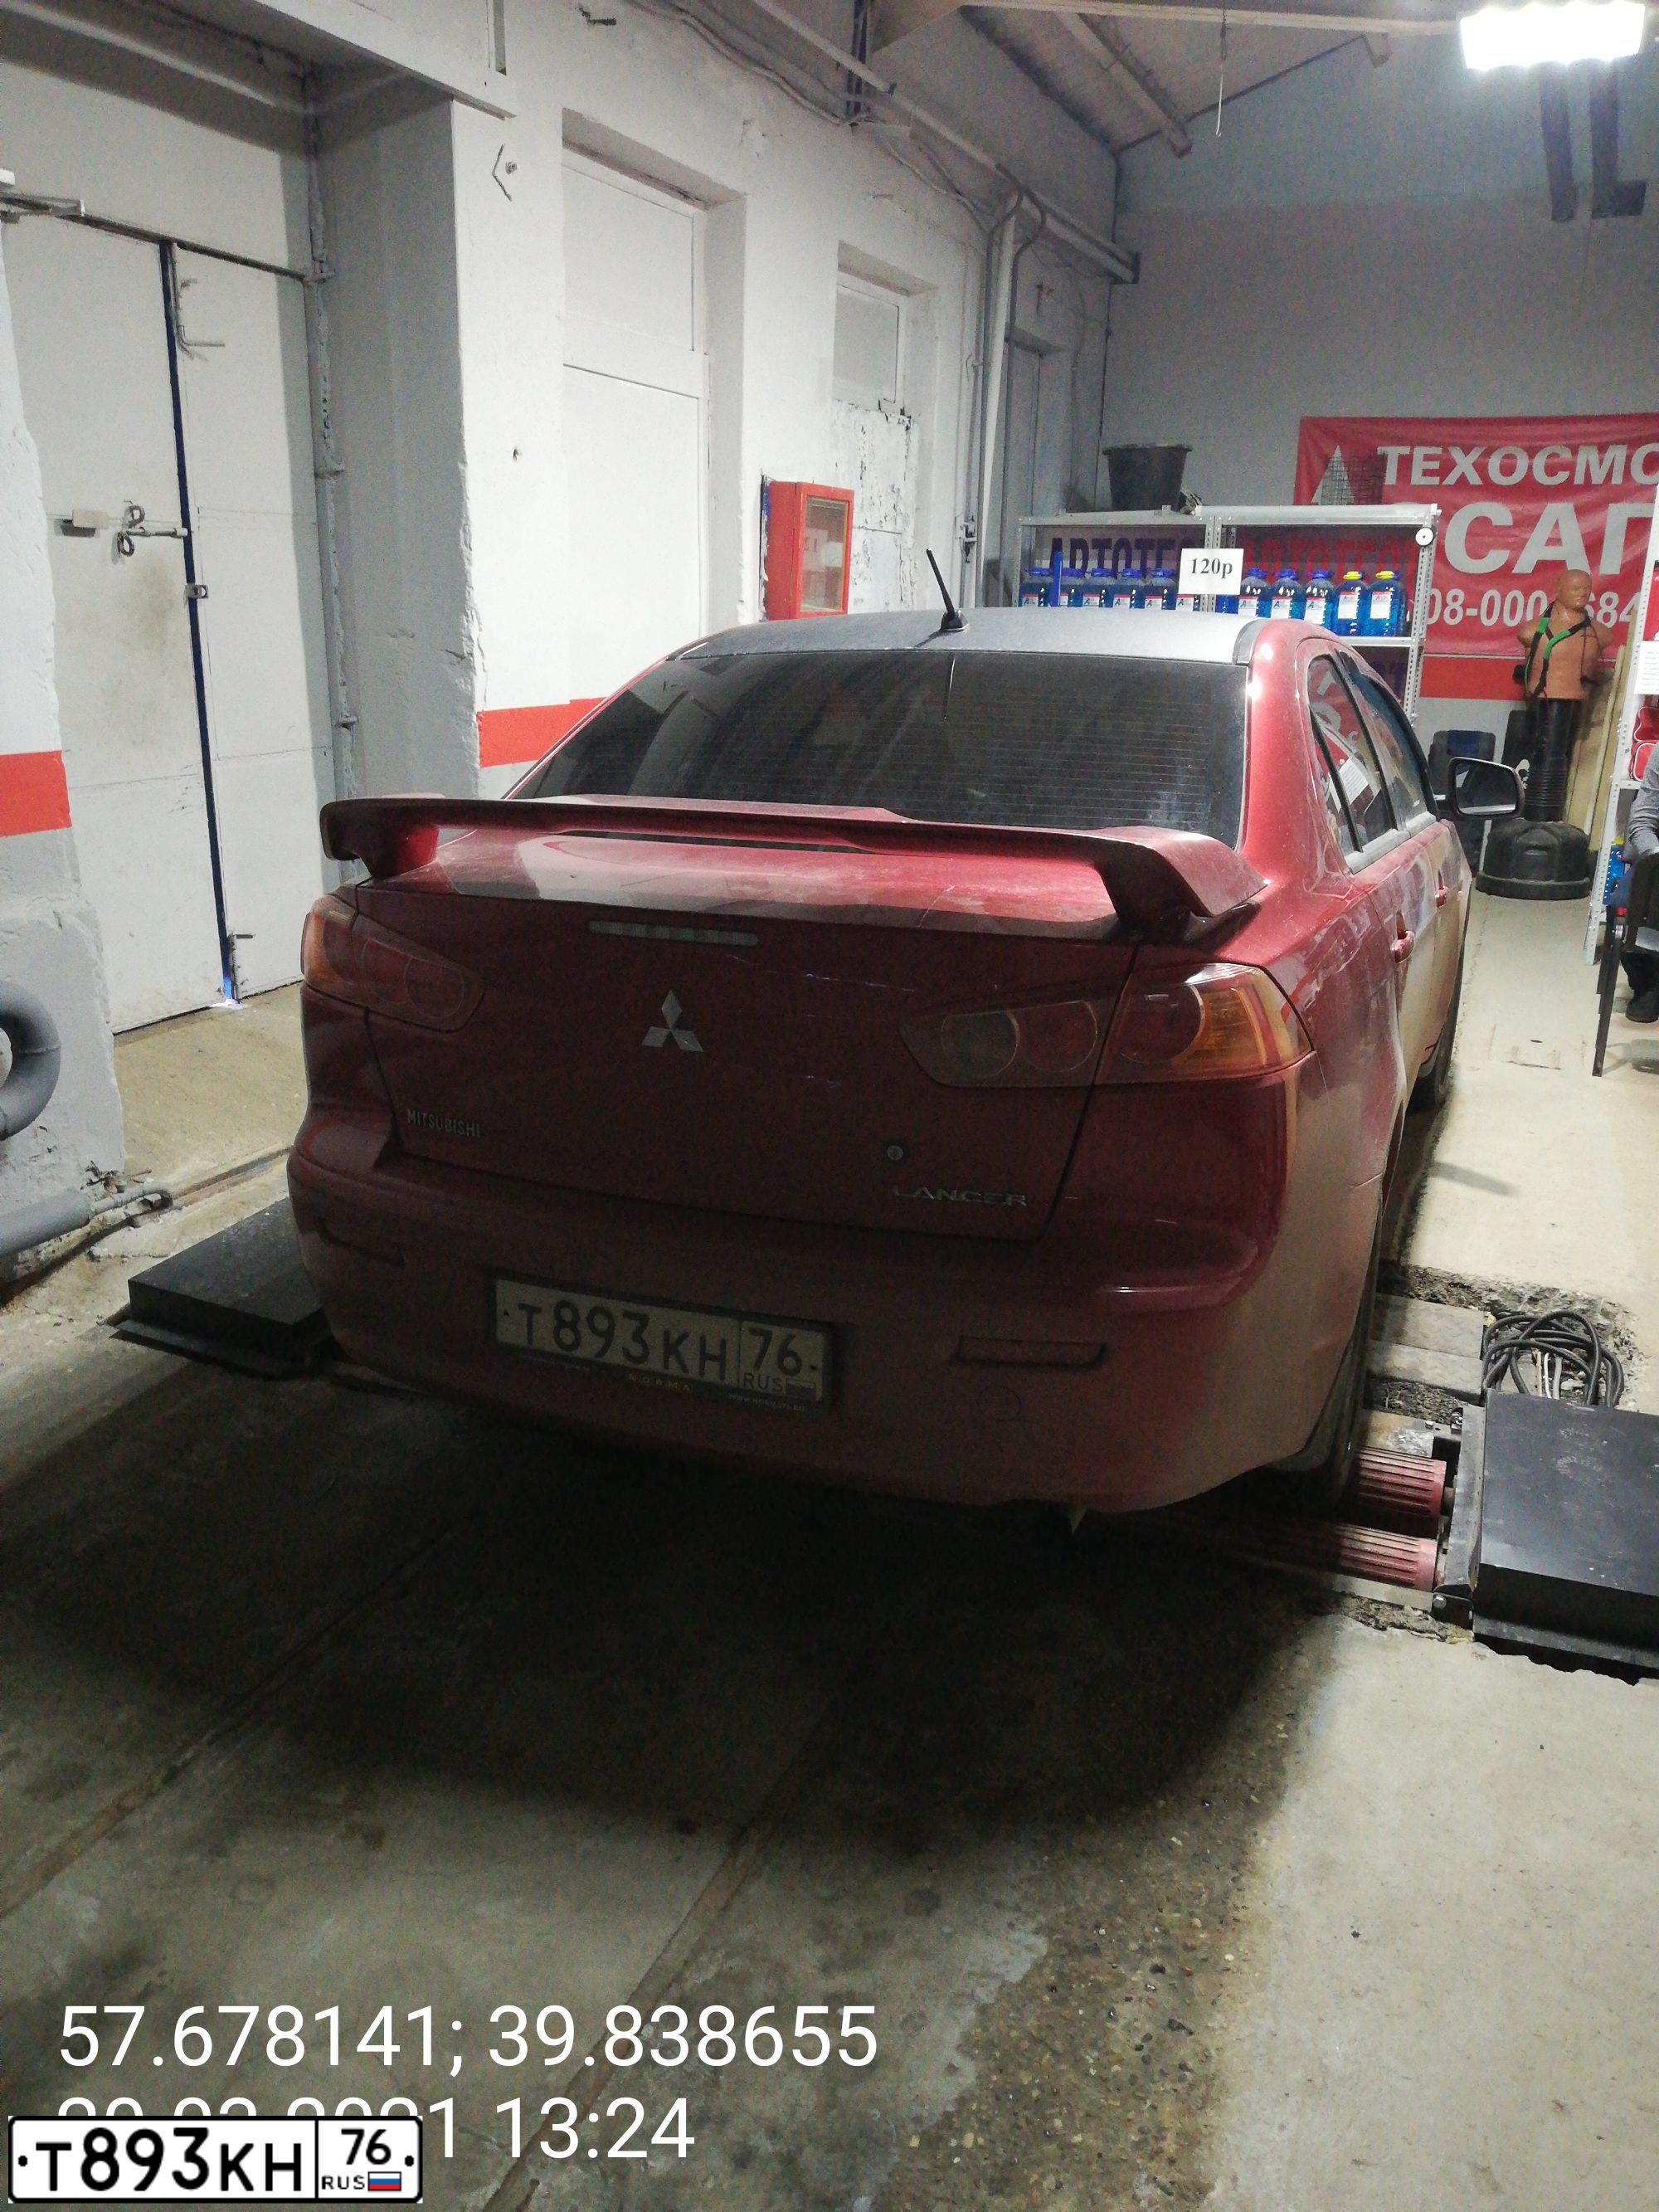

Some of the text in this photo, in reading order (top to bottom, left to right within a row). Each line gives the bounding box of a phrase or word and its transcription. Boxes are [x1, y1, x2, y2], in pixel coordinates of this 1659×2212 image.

[406, 1108, 480, 1138] MITSUBISHI
[892, 1184, 1027, 1208] LANCER
[749, 1328, 803, 1377] 76
[744, 1372, 784, 1393] RUS
